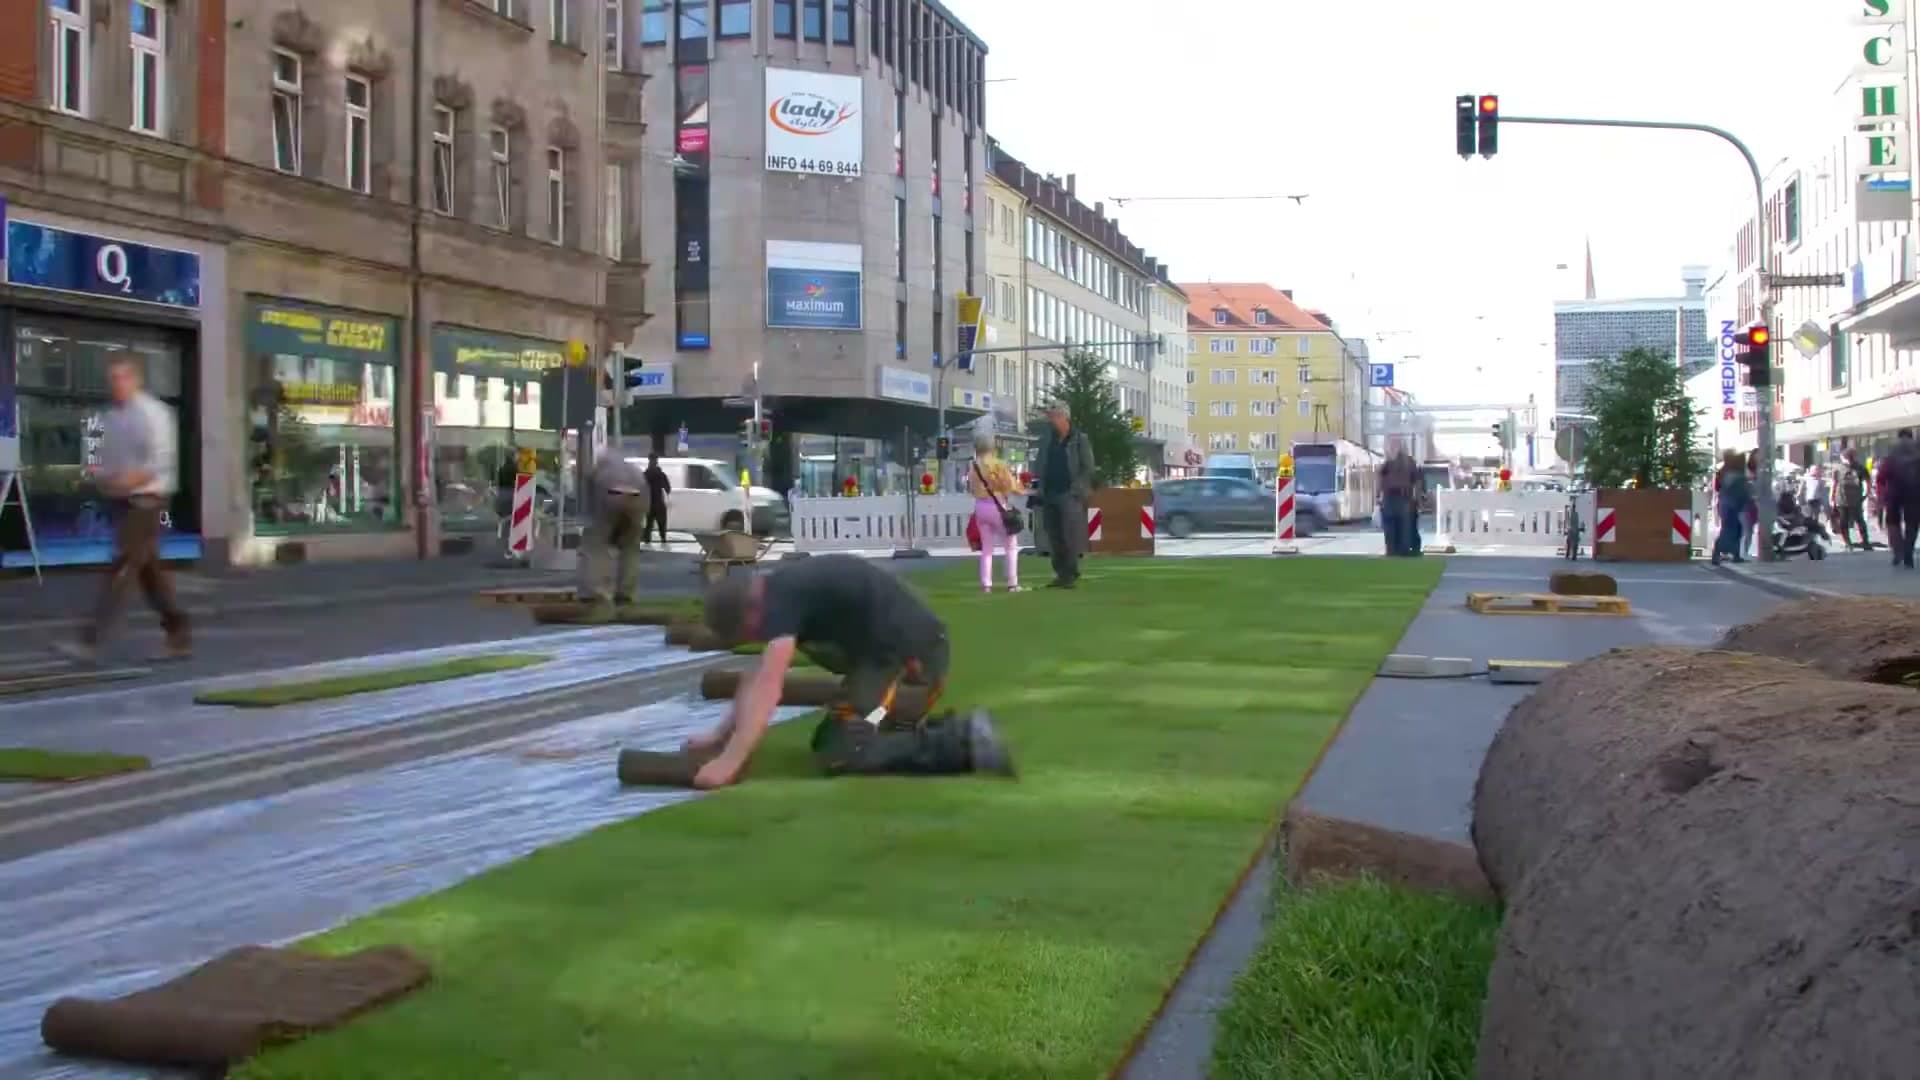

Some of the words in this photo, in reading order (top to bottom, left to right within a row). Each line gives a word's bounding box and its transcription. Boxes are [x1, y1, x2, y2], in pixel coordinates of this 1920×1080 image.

[780, 98, 836, 127] lady
[767, 155, 797, 170] INFO
[800, 158, 815, 171] 44
[818, 160, 833, 173] 69
[836, 161, 858, 175] 844
[1371, 364, 1388, 385] P
[1721, 320, 1736, 405] MEDICON
